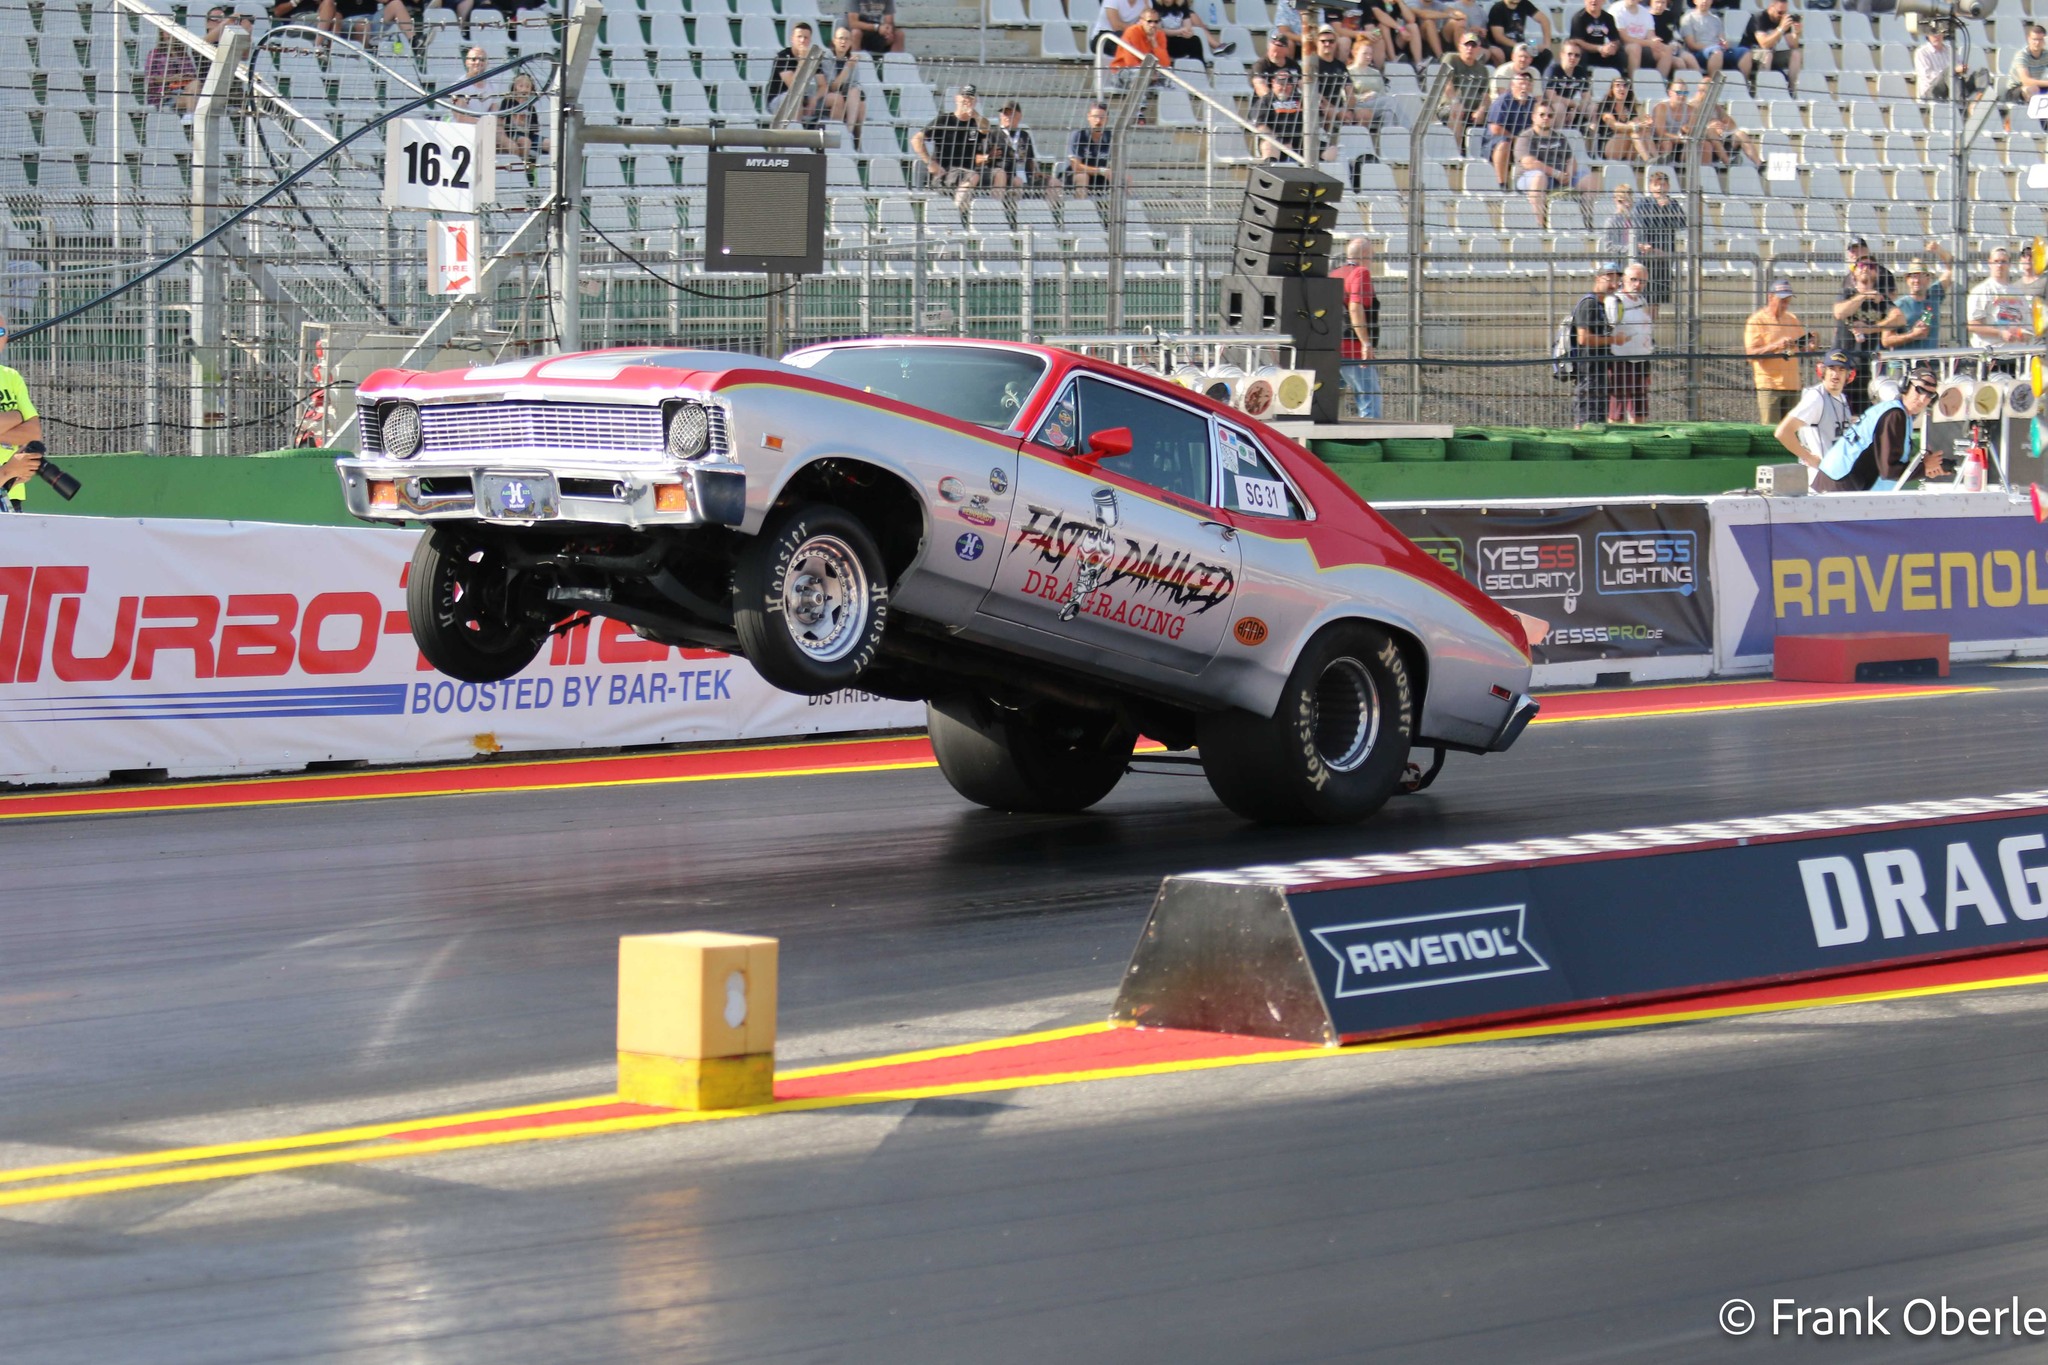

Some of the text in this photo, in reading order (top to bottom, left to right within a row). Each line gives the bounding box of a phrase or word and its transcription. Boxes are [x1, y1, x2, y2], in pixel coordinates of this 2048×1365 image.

[403, 141, 471, 189] 16.2
[746, 159, 789, 167] MYLAPS
[1245, 482, 1264, 507] SG
[1265, 485, 1279, 509] 31
[1007, 504, 1102, 574] FAST
[1483, 544, 1575, 571] YESSS
[1601, 539, 1690, 565] YESSS
[765, 522, 807, 613] Hoosier
[1485, 572, 1576, 590] SECURITY
[1603, 566, 1693, 586] LIGHTING
[1772, 550, 2048, 618] RAVENOL
[855, 582, 889, 674] Hoosier
[412, 669, 732, 715] BOOSTED BY BAR-TEK
[1797, 833, 2048, 948] DRAG
